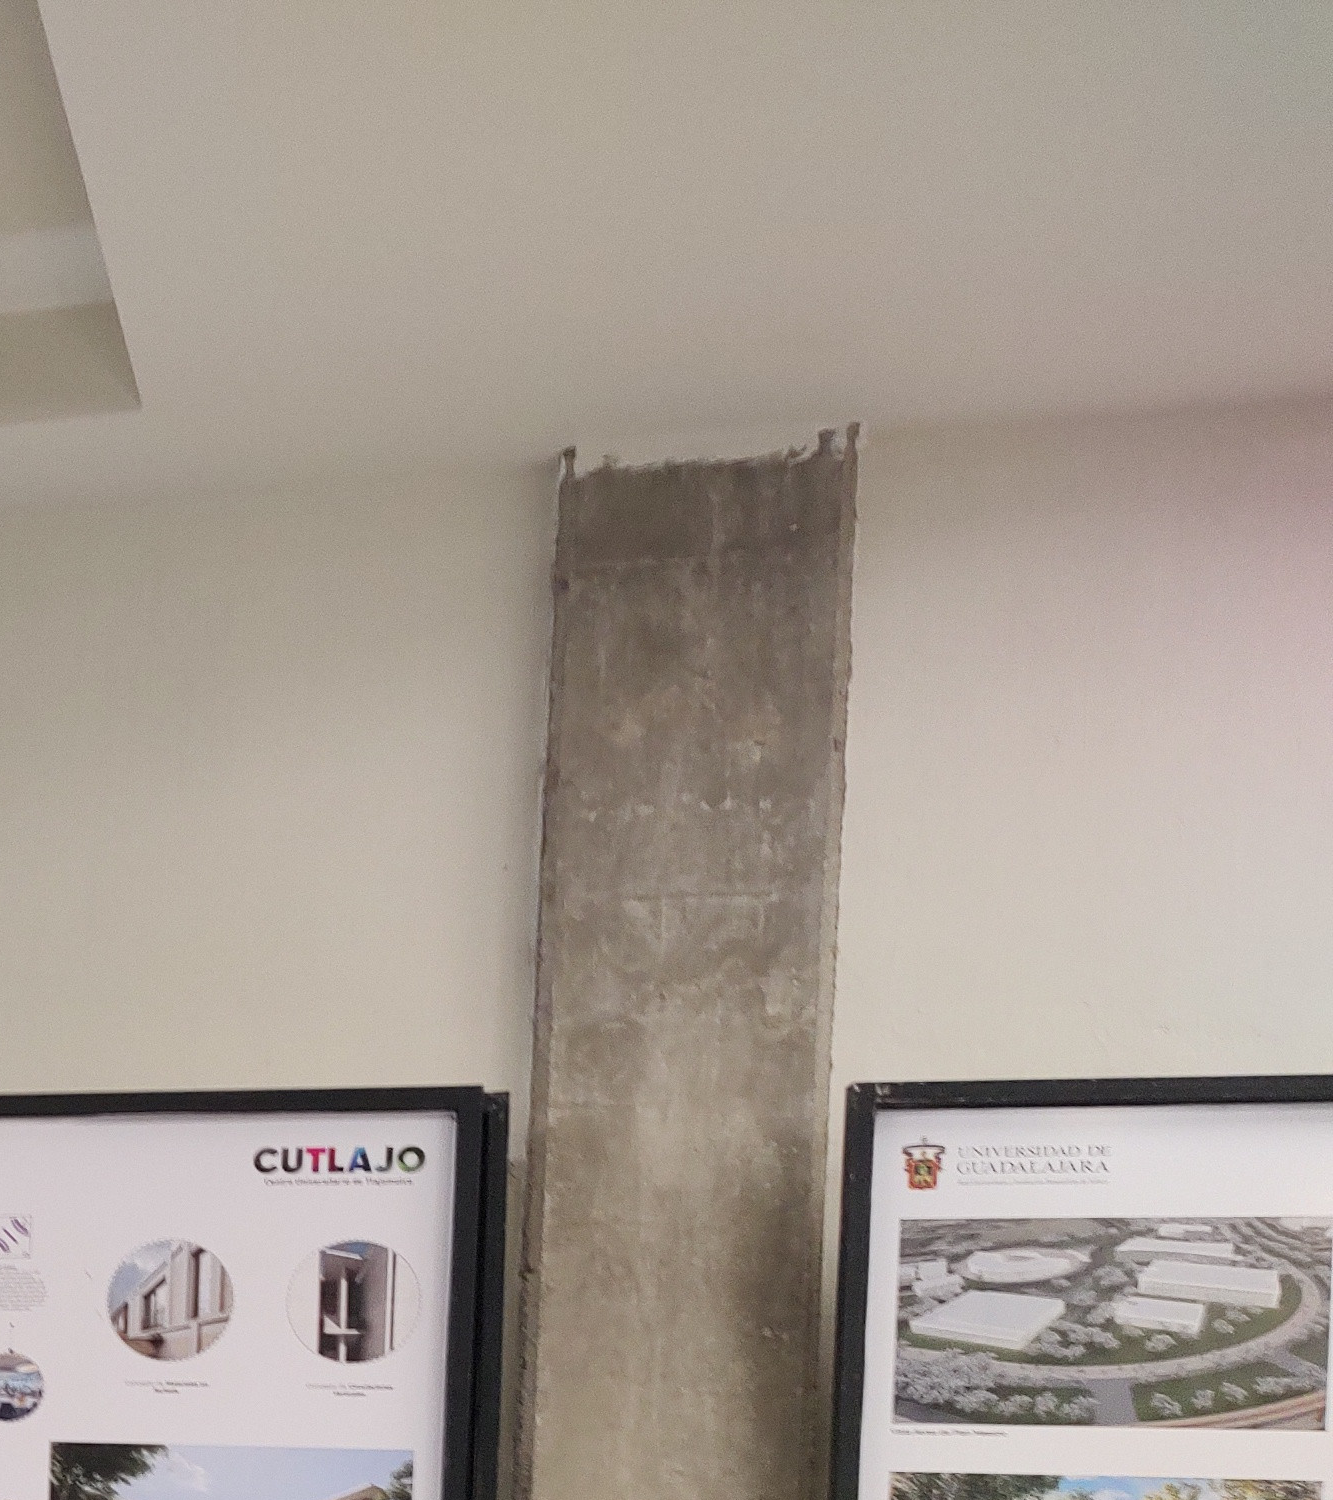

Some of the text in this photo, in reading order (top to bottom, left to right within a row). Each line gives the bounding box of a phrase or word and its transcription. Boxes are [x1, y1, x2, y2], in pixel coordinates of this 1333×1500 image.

[253, 1146, 426, 1173] CUTLAJO
[957, 1144, 1112, 1159] UNIVERSIDAD DE
[956, 1159, 1111, 1175] GUADALAJARA
